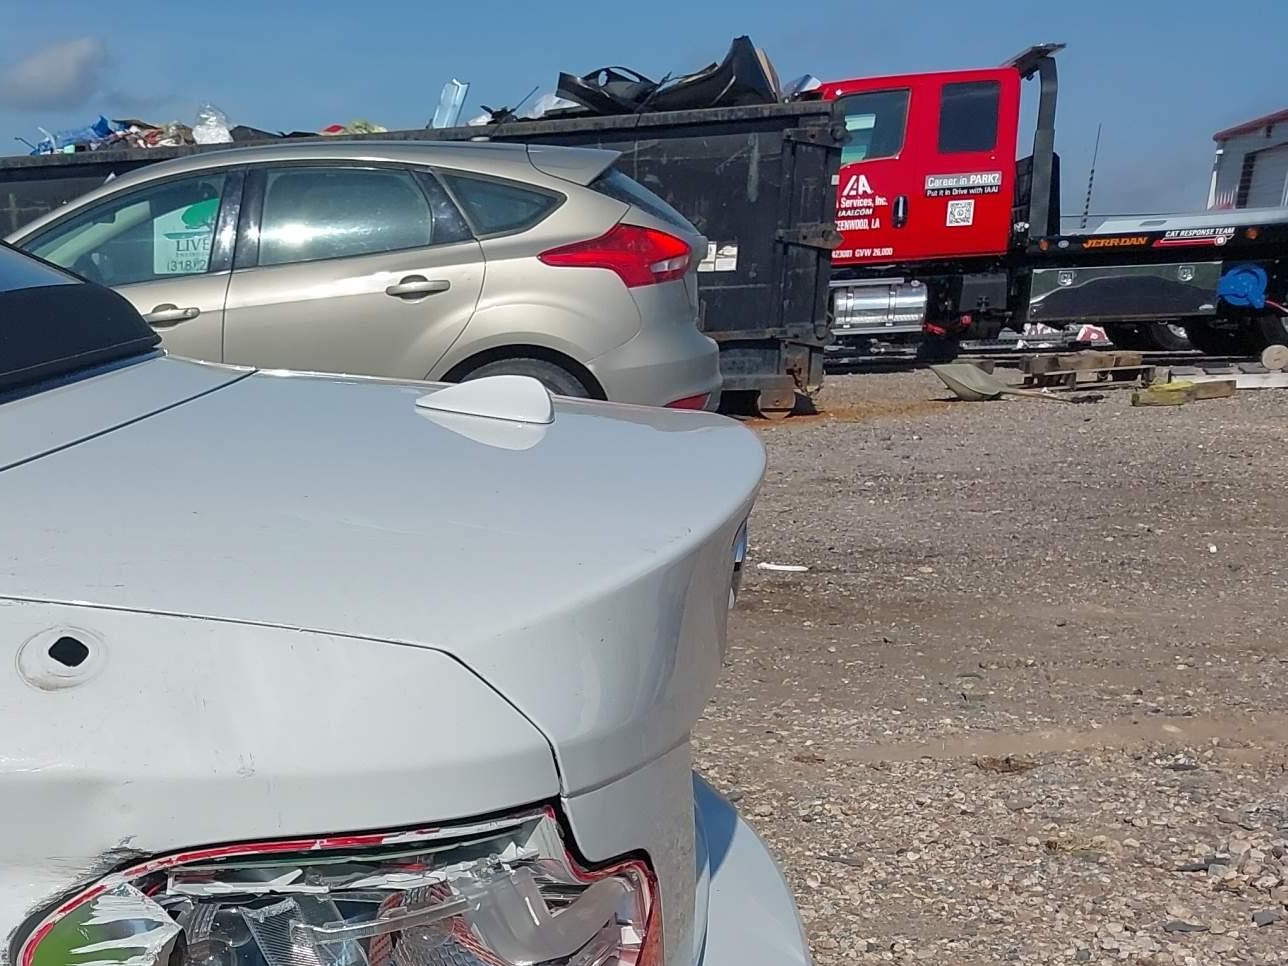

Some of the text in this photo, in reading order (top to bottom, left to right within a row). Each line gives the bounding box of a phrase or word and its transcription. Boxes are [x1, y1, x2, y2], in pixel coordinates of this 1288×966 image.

[928, 174, 1000, 187] Career in PARK?
[969, 187, 983, 195] with
[840, 196, 874, 208] Services,
[875, 195, 888, 206] Inc.
[835, 218, 880, 231] EENWOOD, LA
[1165, 230, 1180, 238] CAT
[1215, 227, 1235, 235] TEAM
[176, 239, 209, 252] LIVE
[855, 248, 872, 257] GVW
